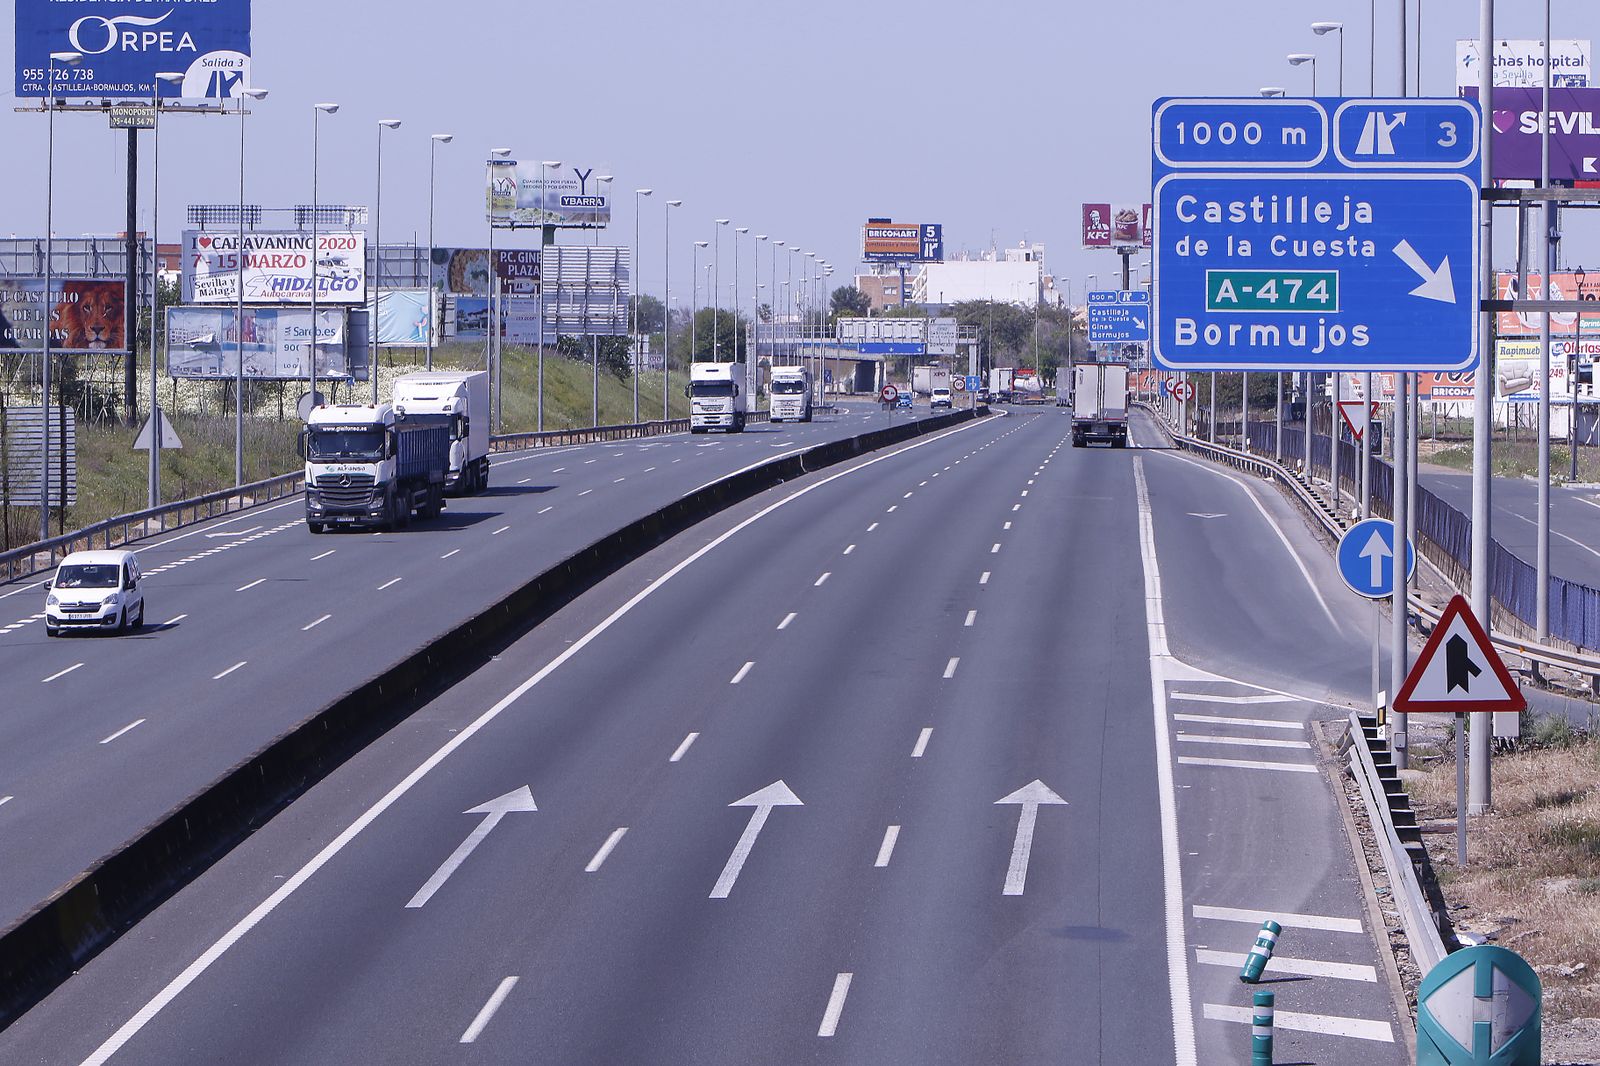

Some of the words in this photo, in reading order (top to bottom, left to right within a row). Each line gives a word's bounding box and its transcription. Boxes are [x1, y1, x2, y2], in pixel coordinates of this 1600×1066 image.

[69, 9, 197, 54] ORPEA
[202, 58, 233, 68] Salida
[237, 58, 243, 67] 3
[22, 69, 44, 80] 955
[49, 69, 69, 80] 726
[73, 69, 94, 80] 738
[1176, 122, 1262, 144] 1000
[1281, 127, 1306, 144] m
[1437, 122, 1457, 147] 3
[563, 197, 603, 206] YBARRA
[1176, 195, 1373, 230] Castilleja
[926, 226, 936, 237] 5
[1087, 231, 1109, 239] KFC
[318, 237, 357, 250] 2020
[1176, 235, 1208, 256] de
[1227, 235, 1252, 256] la
[1270, 235, 1375, 256] Cuesta
[191, 254, 201, 268] 7
[217, 254, 238, 268] 15
[242, 254, 307, 268] MARZO
[508, 265, 539, 276] PLAZA
[195, 278, 228, 290] Sevilla
[230, 278, 236, 287] y
[272, 277, 358, 291] HIDALGO
[260, 289, 326, 298] Autocaravaas
[1215, 279, 1329, 303] A-474
[13, 310, 31, 321] DE
[35, 310, 60, 321] LS
[4, 328, 69, 340] GUARAS
[1091, 331, 1130, 339] Bormujos
[1175, 318, 1370, 354] Bormujos
